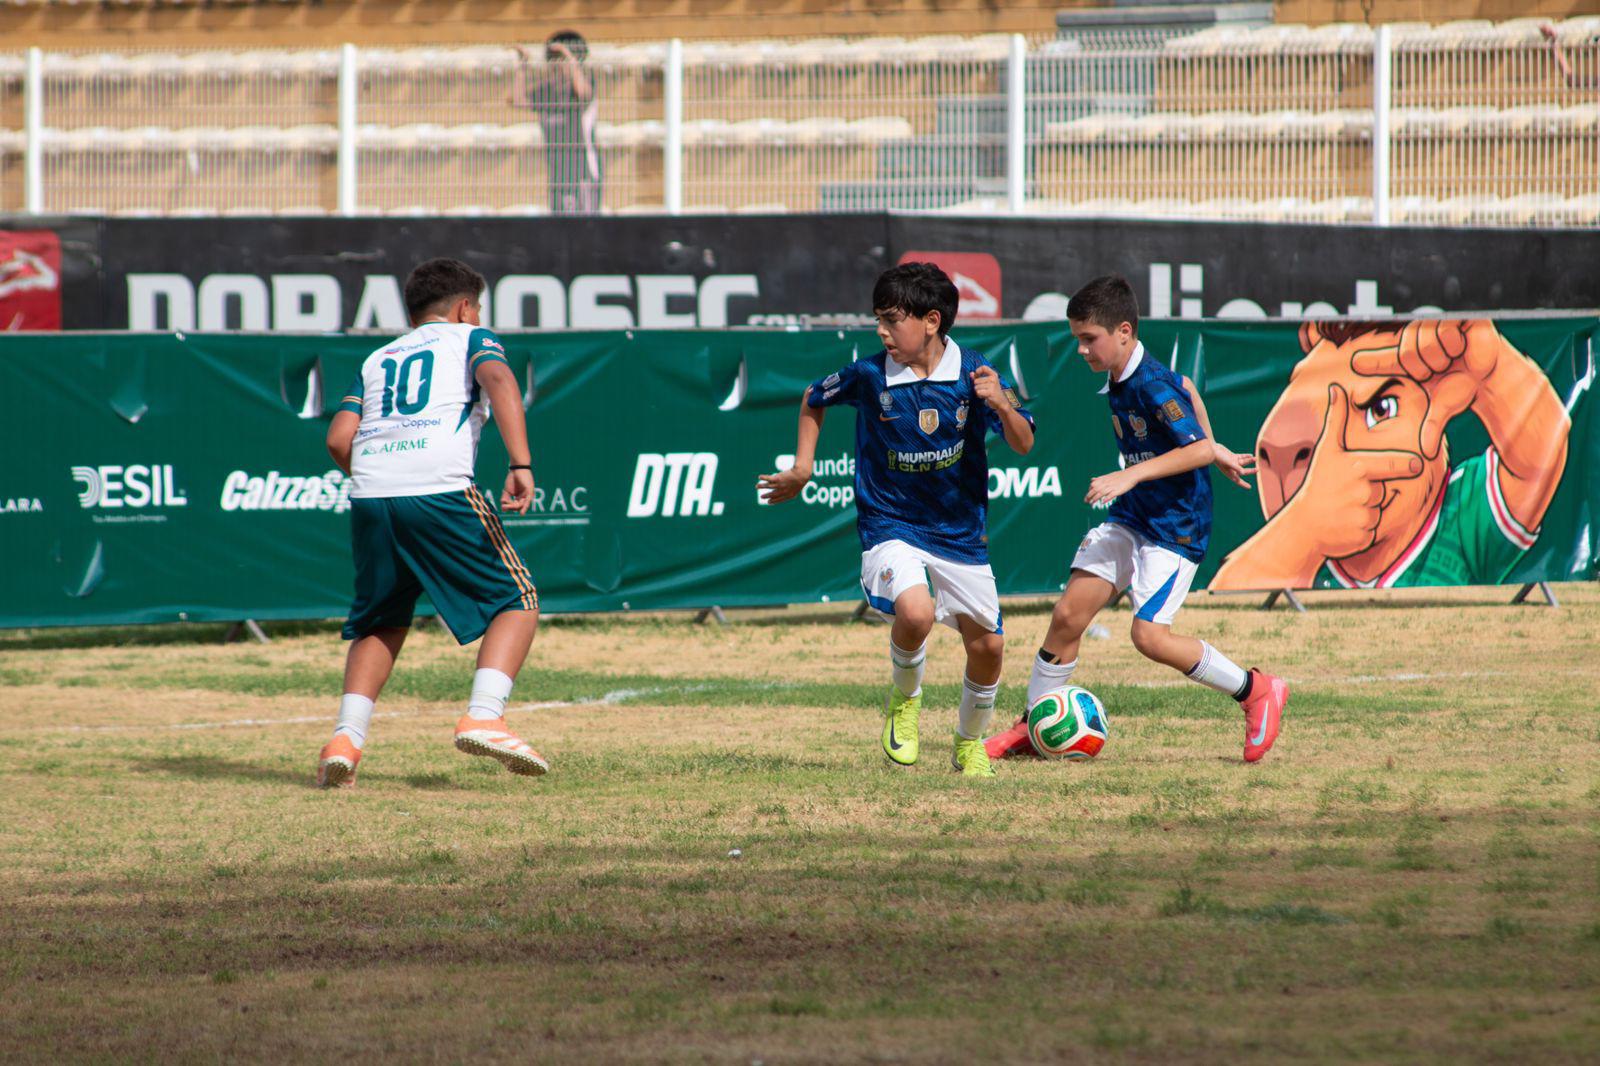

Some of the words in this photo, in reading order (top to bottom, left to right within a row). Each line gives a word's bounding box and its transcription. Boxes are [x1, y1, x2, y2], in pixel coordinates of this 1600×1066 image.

[381, 349, 435, 418] 10
[379, 437, 430, 453] AFIRME
[71, 464, 188, 509] DESIL
[220, 469, 353, 514] CalzzaSp
[626, 452, 725, 518] DTA.
[987, 466, 1062, 500] OMA
